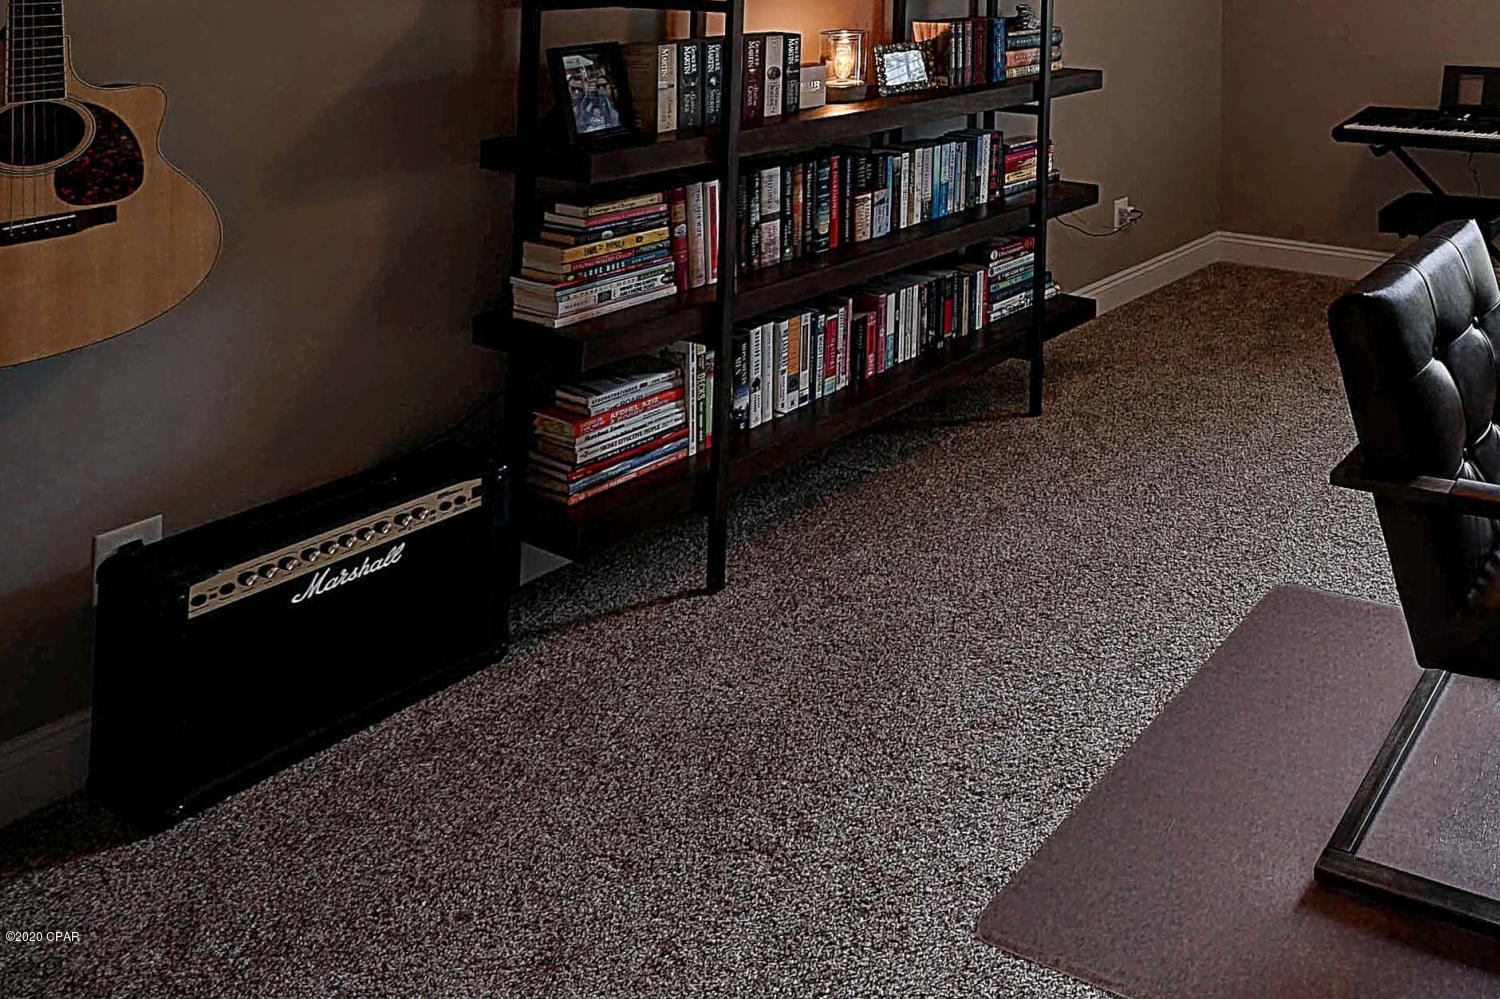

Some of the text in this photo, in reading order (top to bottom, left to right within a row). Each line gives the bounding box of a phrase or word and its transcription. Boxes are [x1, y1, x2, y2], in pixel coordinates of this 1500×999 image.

[661, 48, 670, 77] MARTIN
[683, 45, 692, 75] MARTIN
[707, 44, 715, 73] MARTIN
[748, 41, 756, 68] MARTIN
[697, 372, 706, 401] DECKS
[291, 542, 406, 603] Marshall
